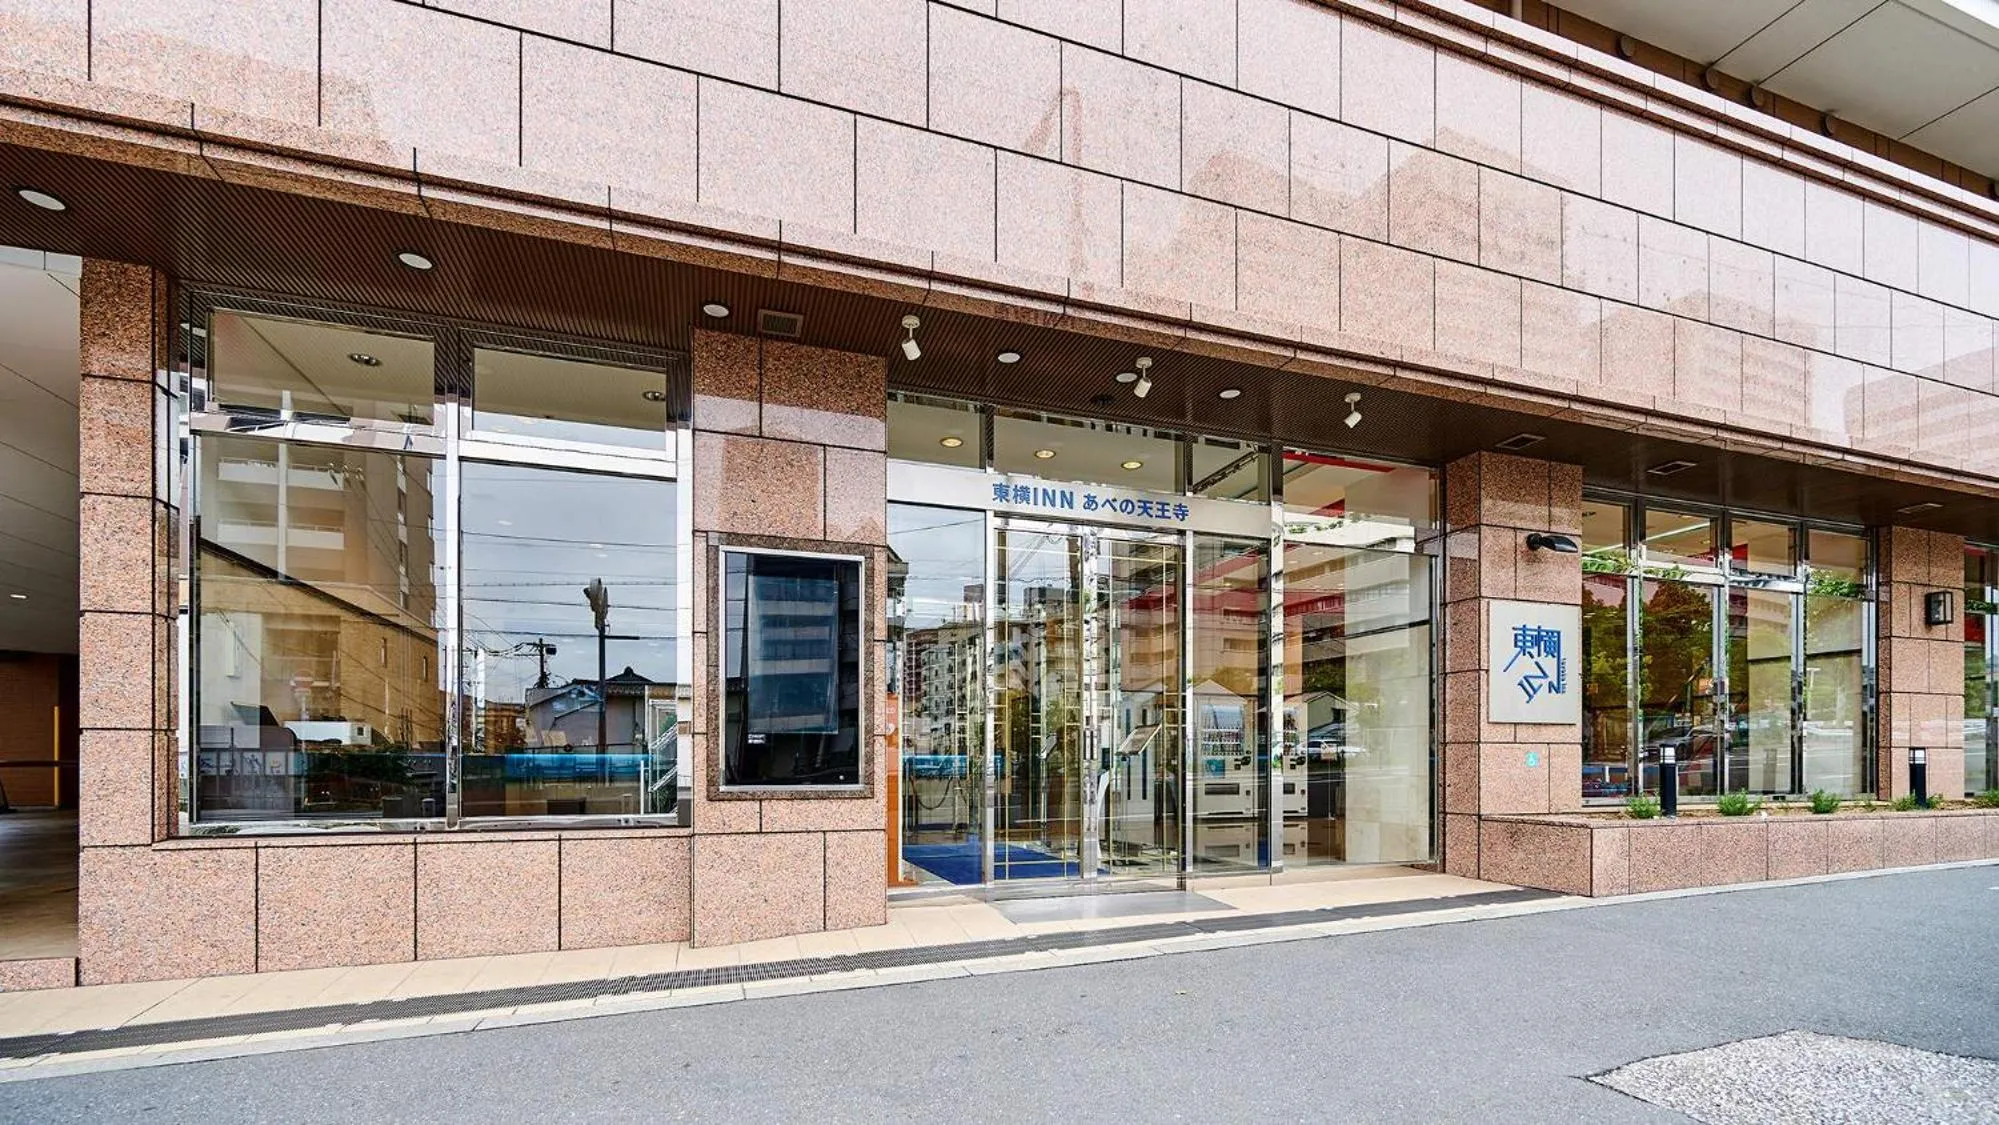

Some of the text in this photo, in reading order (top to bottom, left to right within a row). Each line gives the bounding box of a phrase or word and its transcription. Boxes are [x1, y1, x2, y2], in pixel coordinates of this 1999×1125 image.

[992, 483, 1189, 522] 東横INN あべの天王寺
